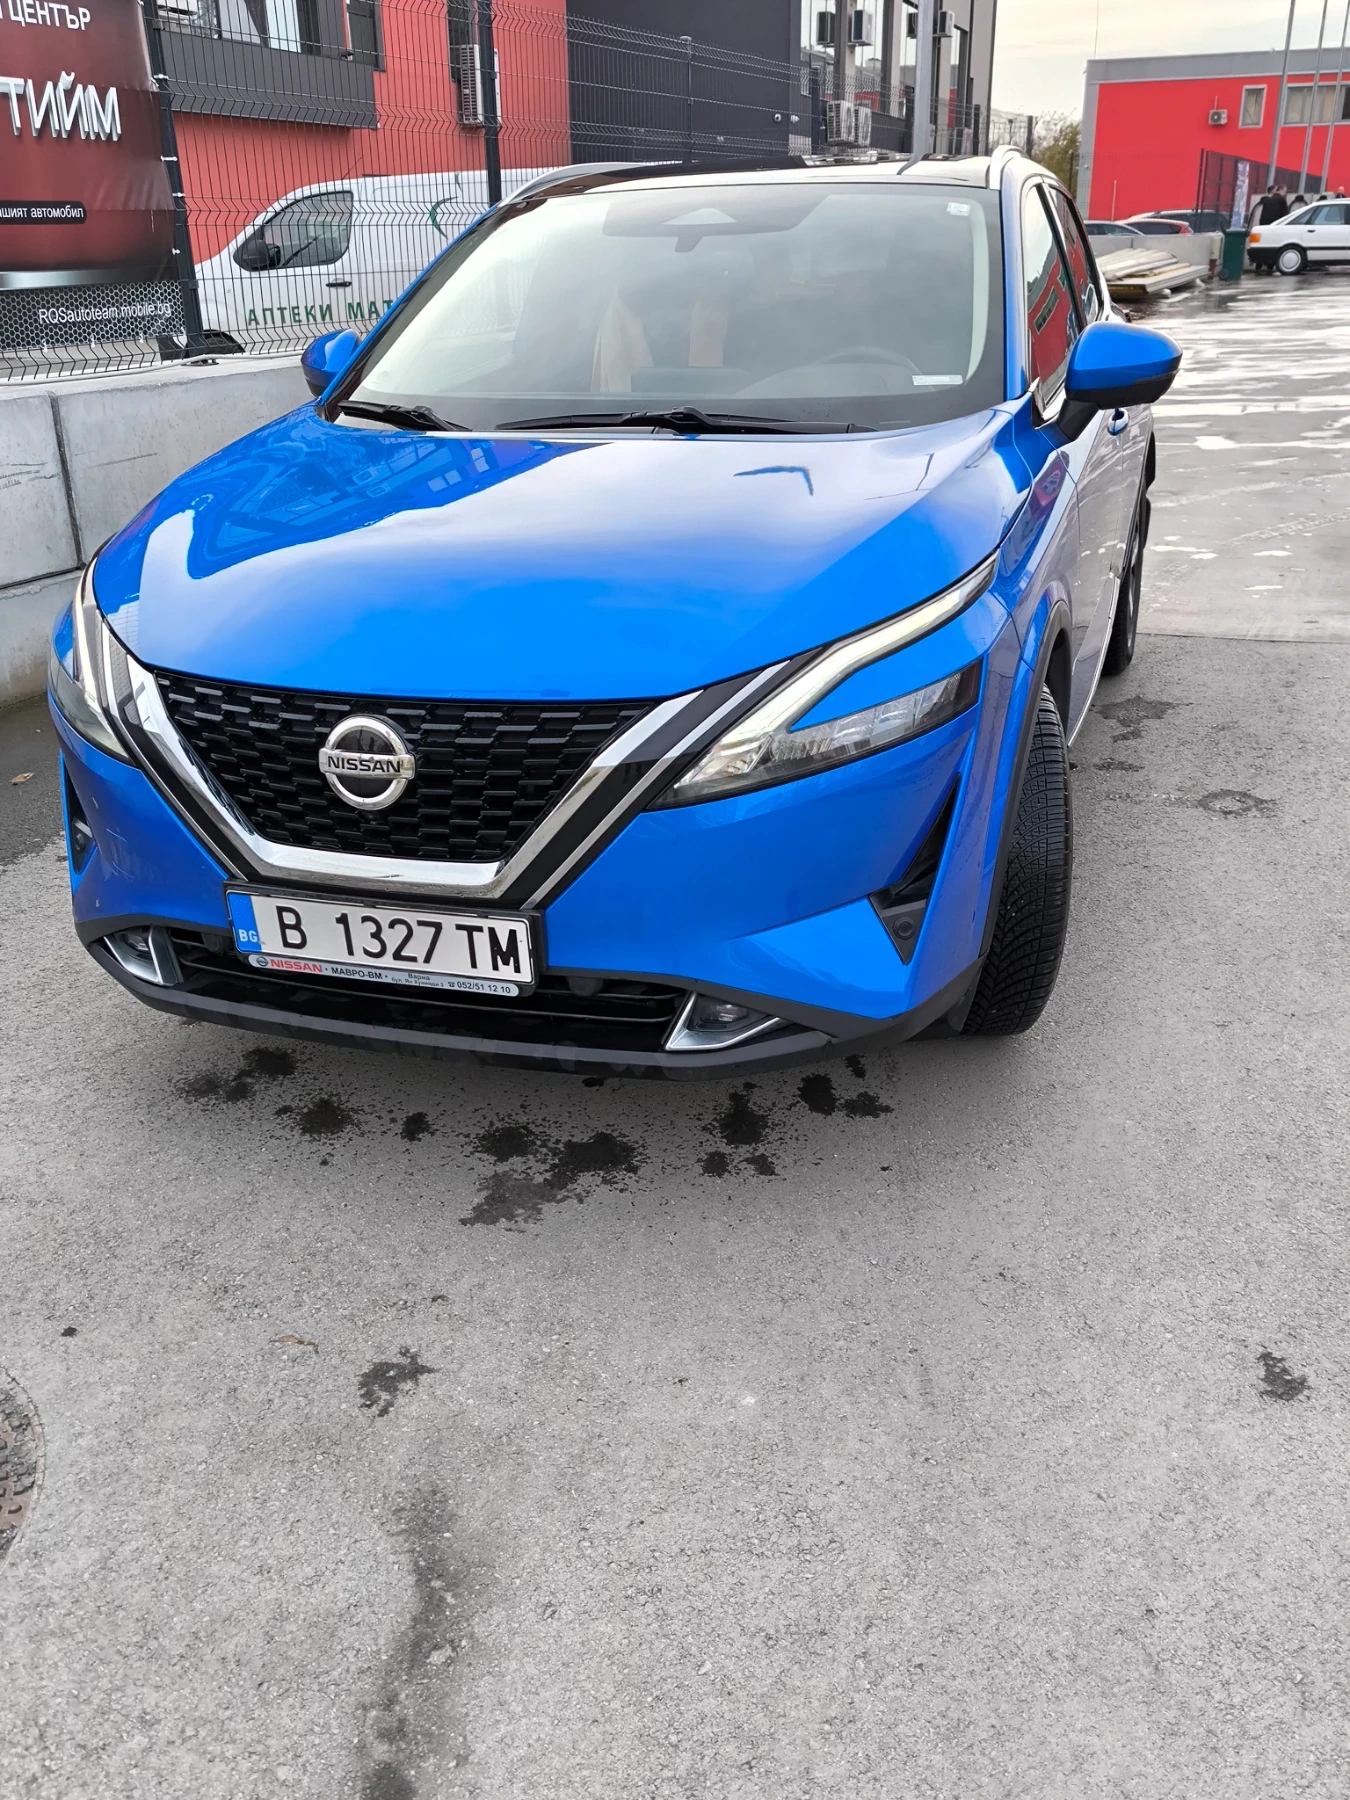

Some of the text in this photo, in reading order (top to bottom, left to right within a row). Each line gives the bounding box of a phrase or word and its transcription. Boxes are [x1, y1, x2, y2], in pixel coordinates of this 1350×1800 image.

[8, 0, 91, 31] ЦЕНТЪР
[30, 204, 84, 218] автомобил
[248, 303, 333, 326] АПТЕКИ
[327, 755, 401, 773] NISSAN
[238, 928, 258, 943] BG
[275, 904, 522, 974] B 1327 TM
[270, 958, 323, 973] NISSAN
[331, 966, 383, 980] МАВРО-ВМ
[408, 972, 431, 981] Варна
[457, 981, 511, 994] 052/51 12 10
